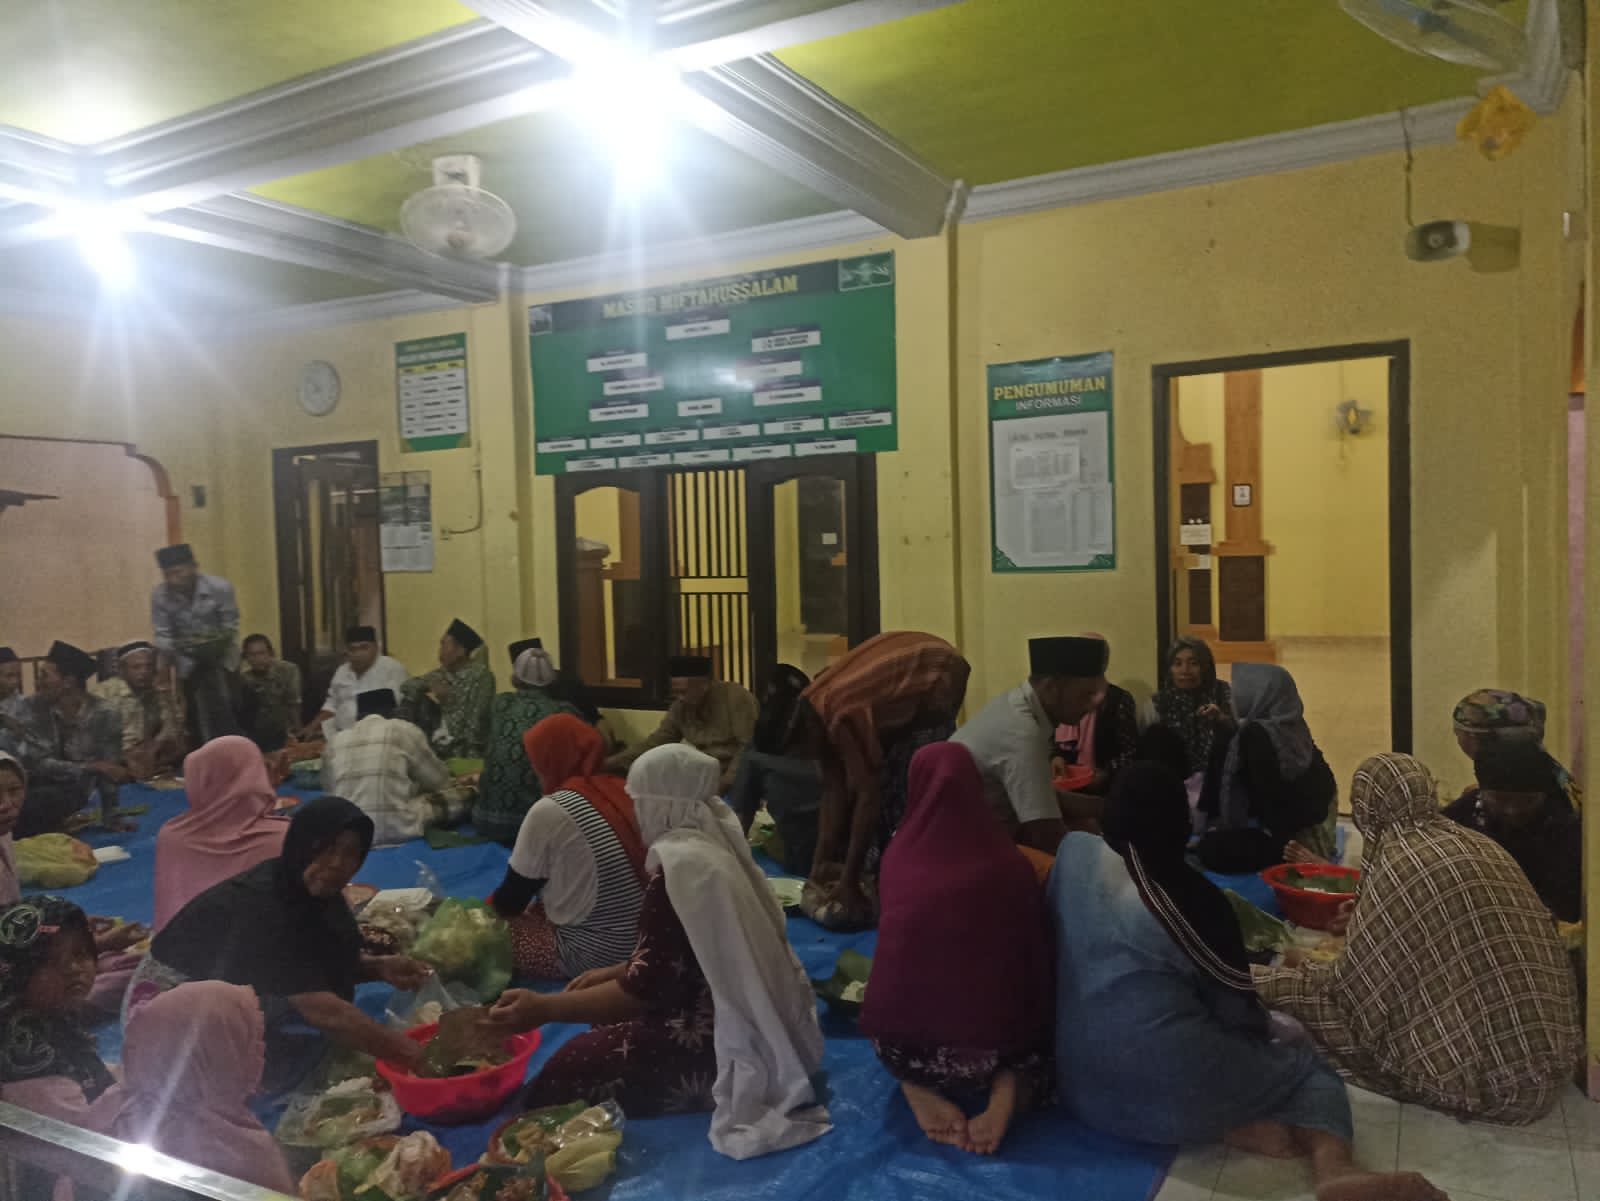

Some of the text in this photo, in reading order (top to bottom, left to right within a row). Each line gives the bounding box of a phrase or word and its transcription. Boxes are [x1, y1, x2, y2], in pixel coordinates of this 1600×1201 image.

[603, 294, 657, 319] MASD
[660, 274, 799, 312] MIFTAHUSSALAM
[994, 376, 1105, 400] PENGUMUMAN
[1016, 394, 1081, 410] INFORMASI
